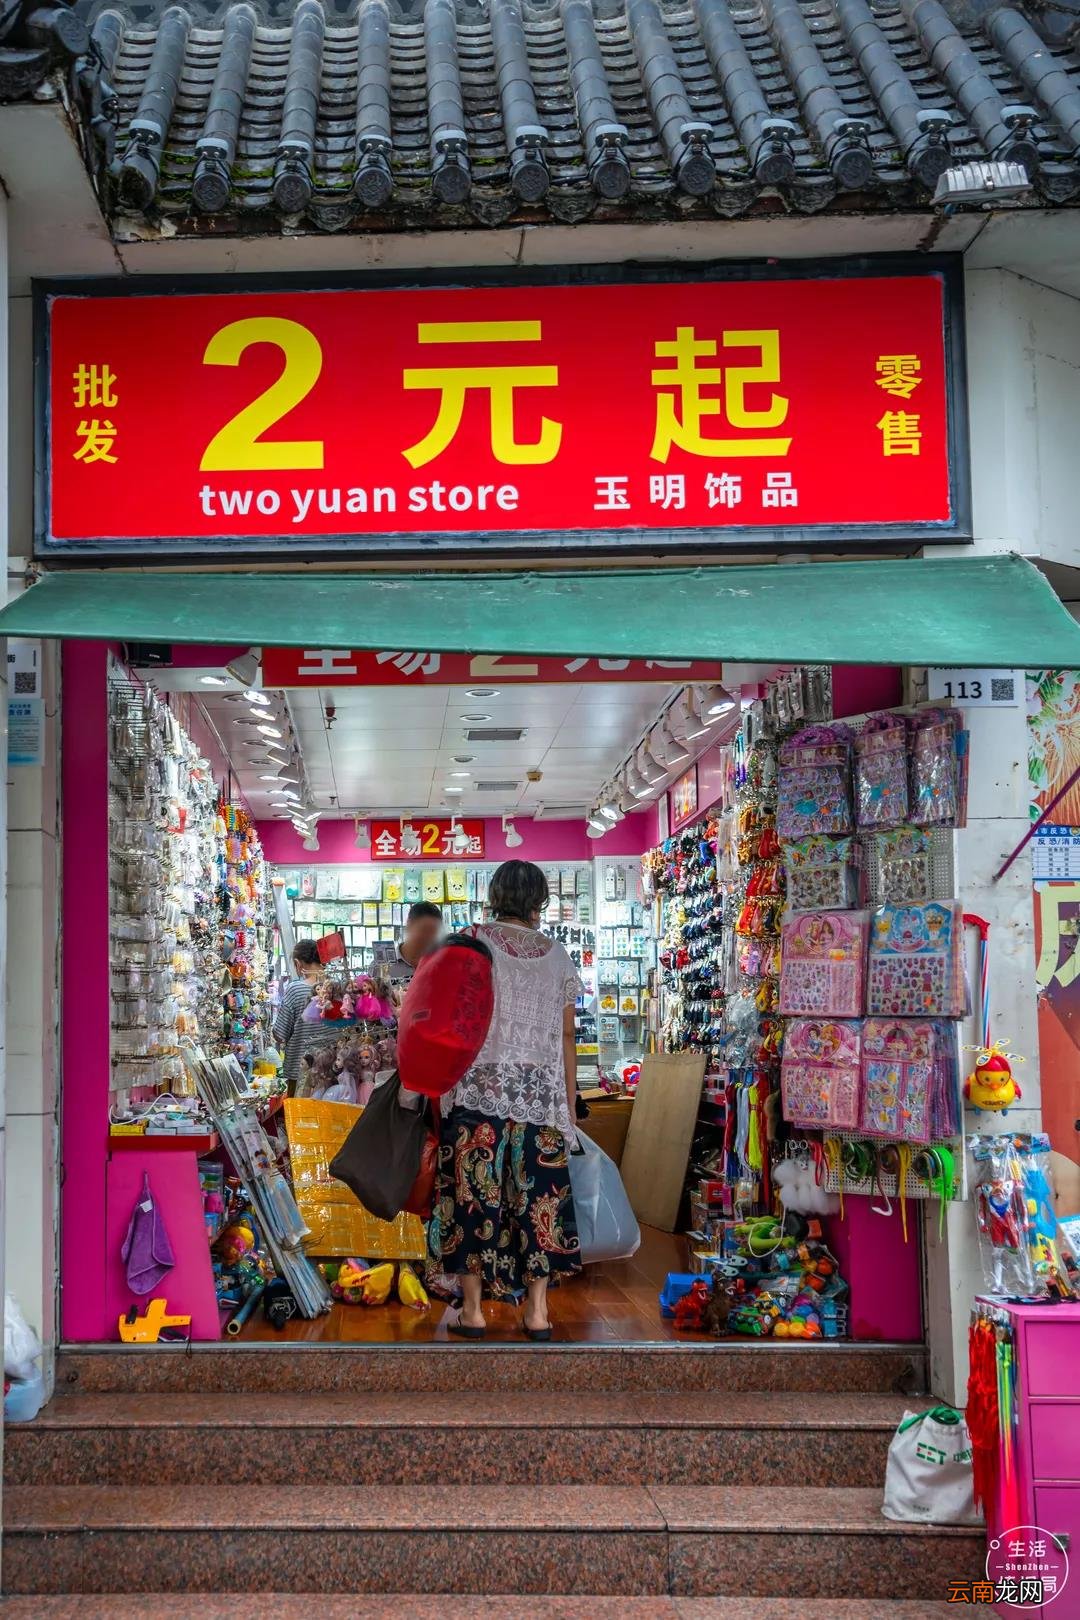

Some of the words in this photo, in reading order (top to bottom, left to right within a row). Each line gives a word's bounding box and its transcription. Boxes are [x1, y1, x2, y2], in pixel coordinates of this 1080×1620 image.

[73, 363, 118, 464] 批发
[199, 316, 793, 472] 2元起
[875, 354, 922, 457] 零售
[199, 484, 281, 516] two
[291, 488, 397, 523] yuan
[408, 480, 519, 512] store
[593, 472, 798, 511] 玉明饰品
[944, 681, 982, 699] 113
